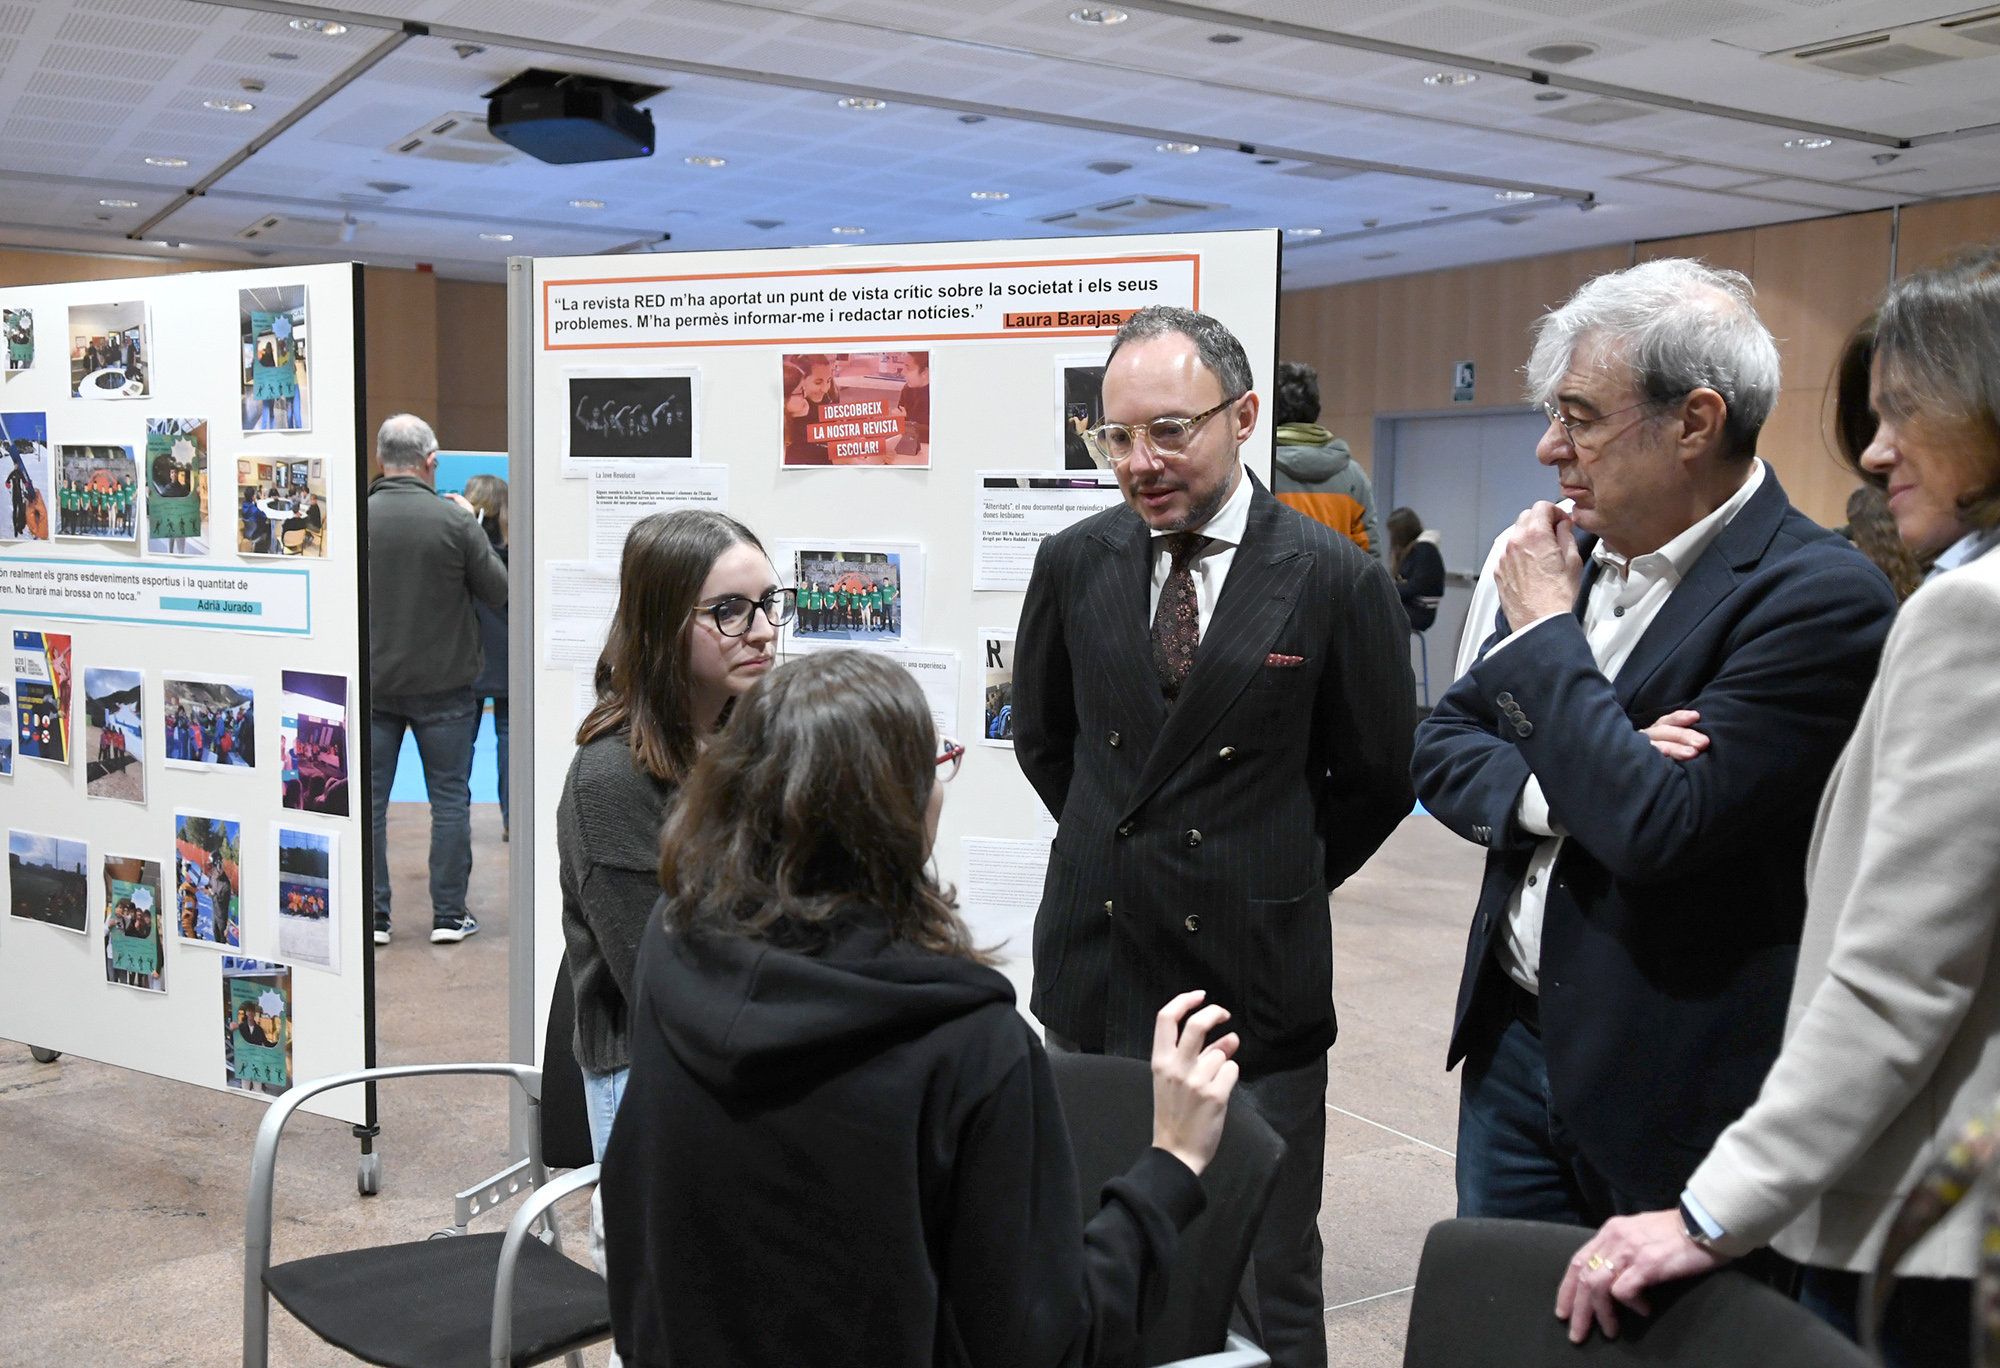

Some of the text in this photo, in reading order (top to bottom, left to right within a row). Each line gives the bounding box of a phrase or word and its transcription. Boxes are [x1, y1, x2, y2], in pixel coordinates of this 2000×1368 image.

[555, 278, 1158, 311] “La revista RED m’ha aportat un punt de vista crític sobre la societat i els seus
[555, 304, 983, 333] problemes. M’ha permès informar-me i redactar notícies.”
[1006, 311, 1120, 328] Laura Barajas
[824, 401, 882, 420] ¡DESCOBREIX
[813, 419, 898, 439] LA NOSTRA REVISTA
[837, 441, 879, 457] ESCOLAR!
[983, 511, 1025, 519] dones lesbianes
[1033, 503, 1064, 511] documental
[1076, 503, 1103, 511] reivindica
[10, 568, 42, 579] realment
[44, 570, 54, 580] els
[57, 572, 78, 582] grans
[80, 572, 140, 584] esdeveniments
[142, 576, 180, 588] esportius
[187, 577, 195, 587] la
[197, 578, 235, 590] quantitat
[237, 579, 248, 590] de
[15, 584, 26, 594] No
[28, 585, 47, 596] tiraré
[49, 586, 62, 597] mai
[65, 587, 91, 598] brossa
[93, 590, 103, 599] on
[105, 591, 115, 600] no
[197, 600, 253, 613] Adrià Jurado
